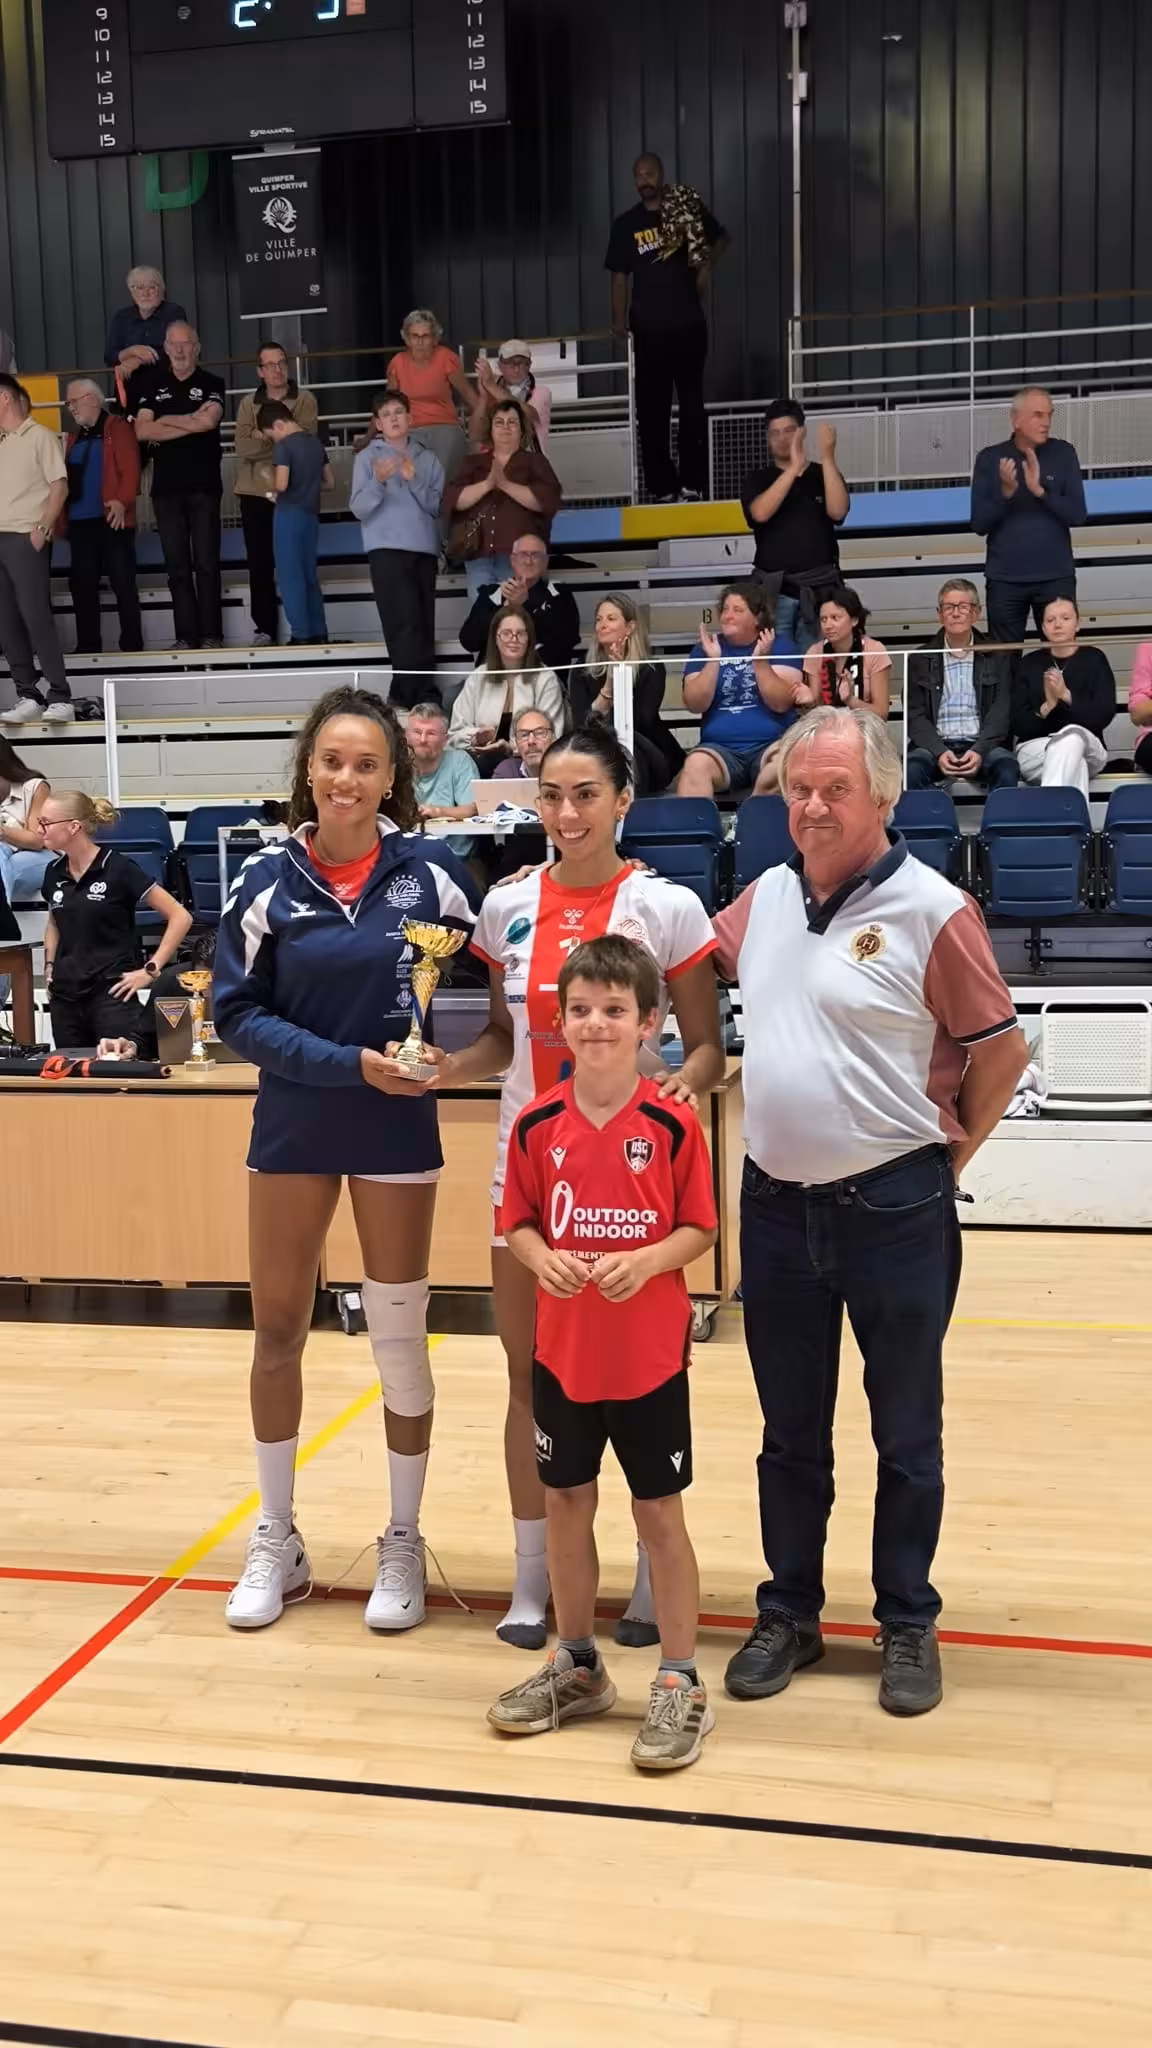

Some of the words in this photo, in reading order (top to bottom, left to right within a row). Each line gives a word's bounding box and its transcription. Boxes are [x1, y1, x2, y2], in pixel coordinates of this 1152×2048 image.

[96, 7, 108, 20] 9
[467, 12, 482, 27] 11
[95, 28, 110, 42] 10
[468, 34, 485, 48] 12
[96, 49, 110, 63] 11
[469, 56, 486, 70] 13
[97, 70, 112, 84] 12
[469, 78, 487, 92] 14
[98, 91, 114, 105] 13
[470, 100, 487, 114] 15
[99, 112, 115, 126] 14
[100, 133, 116, 147] 15
[261, 174, 295, 184] QUIMPER
[248, 185, 270, 193] VILLE
[271, 181, 308, 191] SPORTIVE
[266, 238, 296, 249] VILLE
[245, 253, 259, 263] DE
[264, 247, 317, 261] QUIMPER
[631, 1141, 648, 1154] USC
[572, 1207, 658, 1224] OUTDOOR
[573, 1223, 648, 1239] INDOOR
